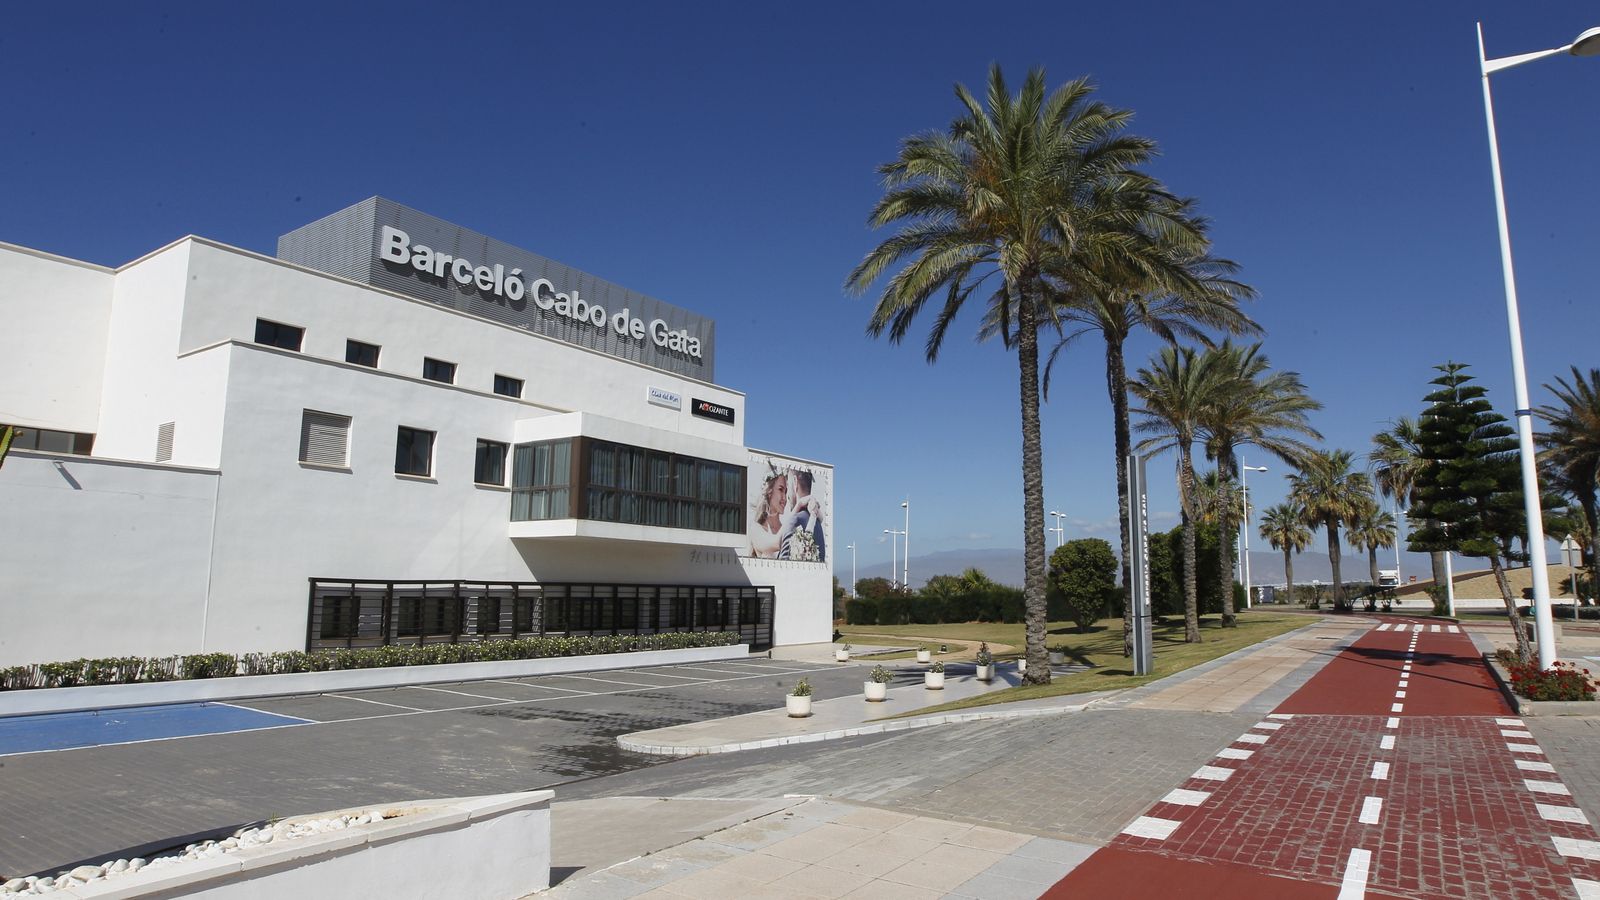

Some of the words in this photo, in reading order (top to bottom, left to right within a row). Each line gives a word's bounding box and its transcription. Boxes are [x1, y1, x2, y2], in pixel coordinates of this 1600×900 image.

[380, 225, 525, 301] Barceló
[531, 278, 607, 327] Cabo
[612, 308, 645, 340] de
[650, 319, 702, 359] Gata
